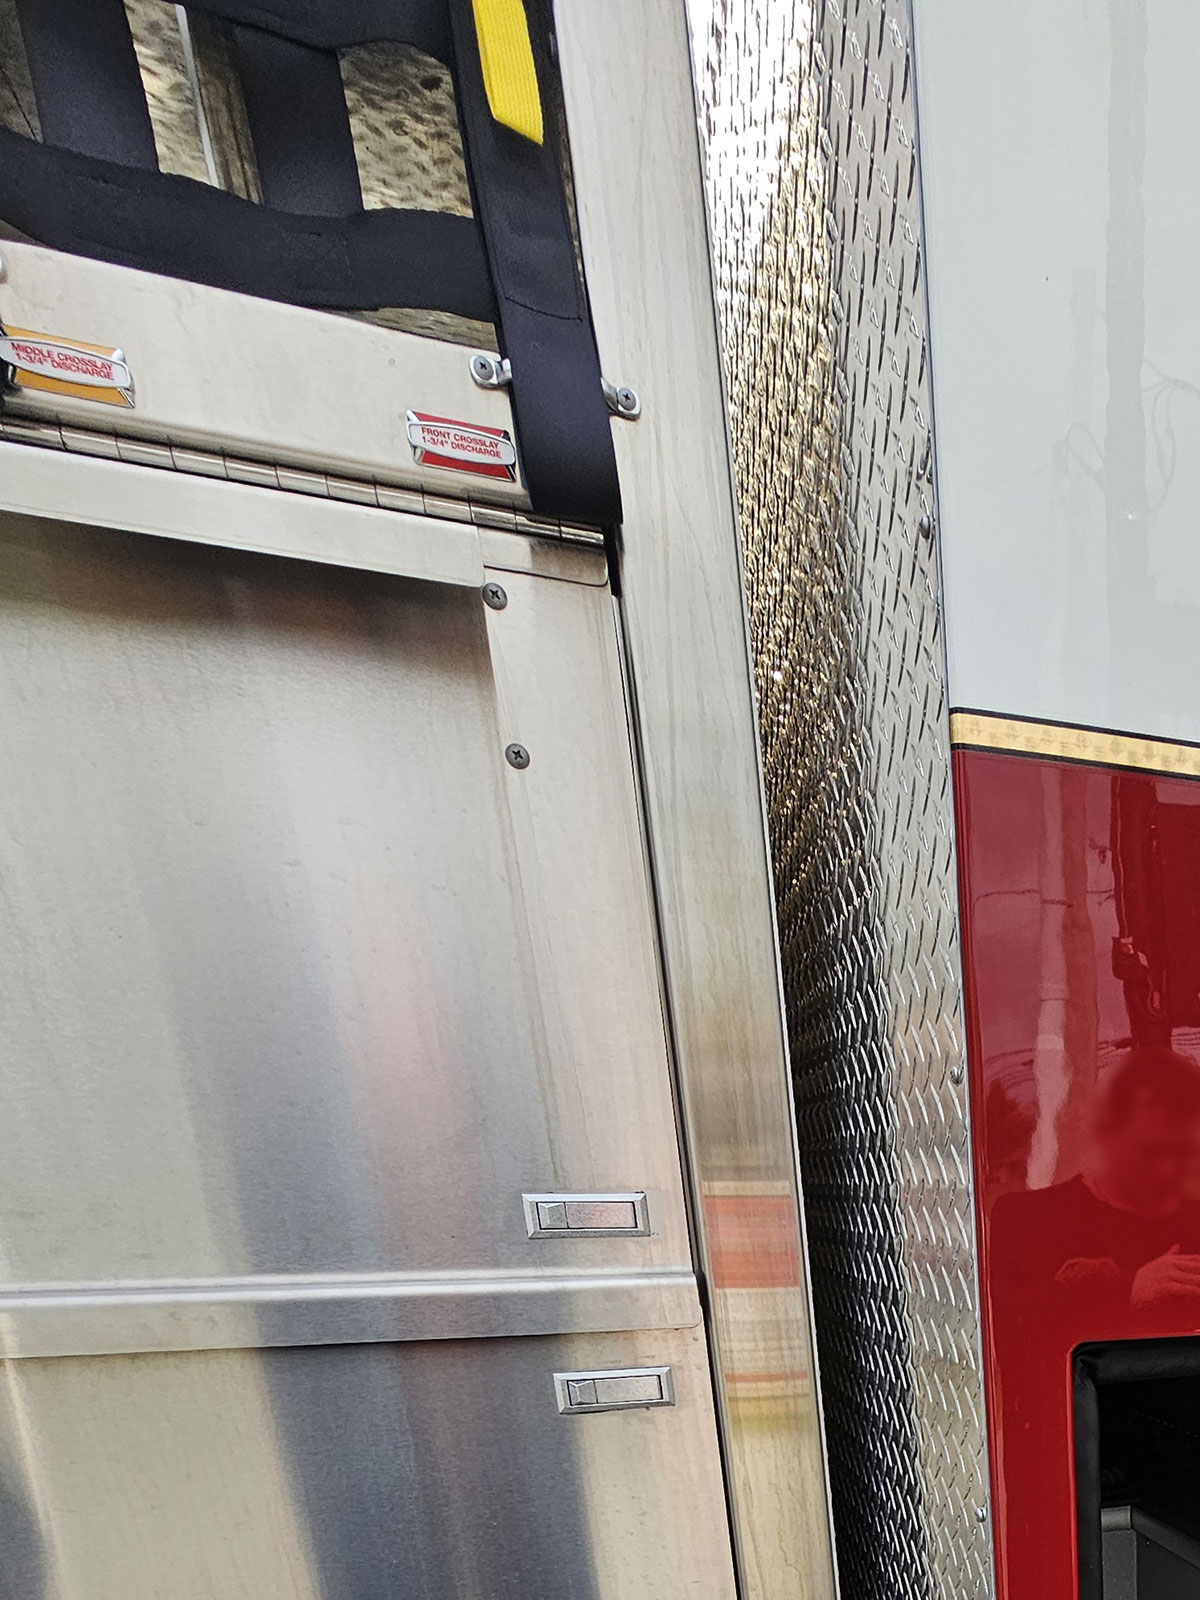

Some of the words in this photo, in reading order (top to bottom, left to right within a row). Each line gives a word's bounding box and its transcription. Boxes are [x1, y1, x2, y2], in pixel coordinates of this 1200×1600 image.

[11, 342, 54, 358] MIDDLE
[57, 353, 113, 371] CROSSLAY
[51, 361, 115, 380] DISCHARGE
[421, 427, 451, 439] FRONT
[454, 434, 499, 449] CROSSLAY
[422, 436, 449, 447] 1-3/4"
[451, 443, 502, 459] DISCHARGE
